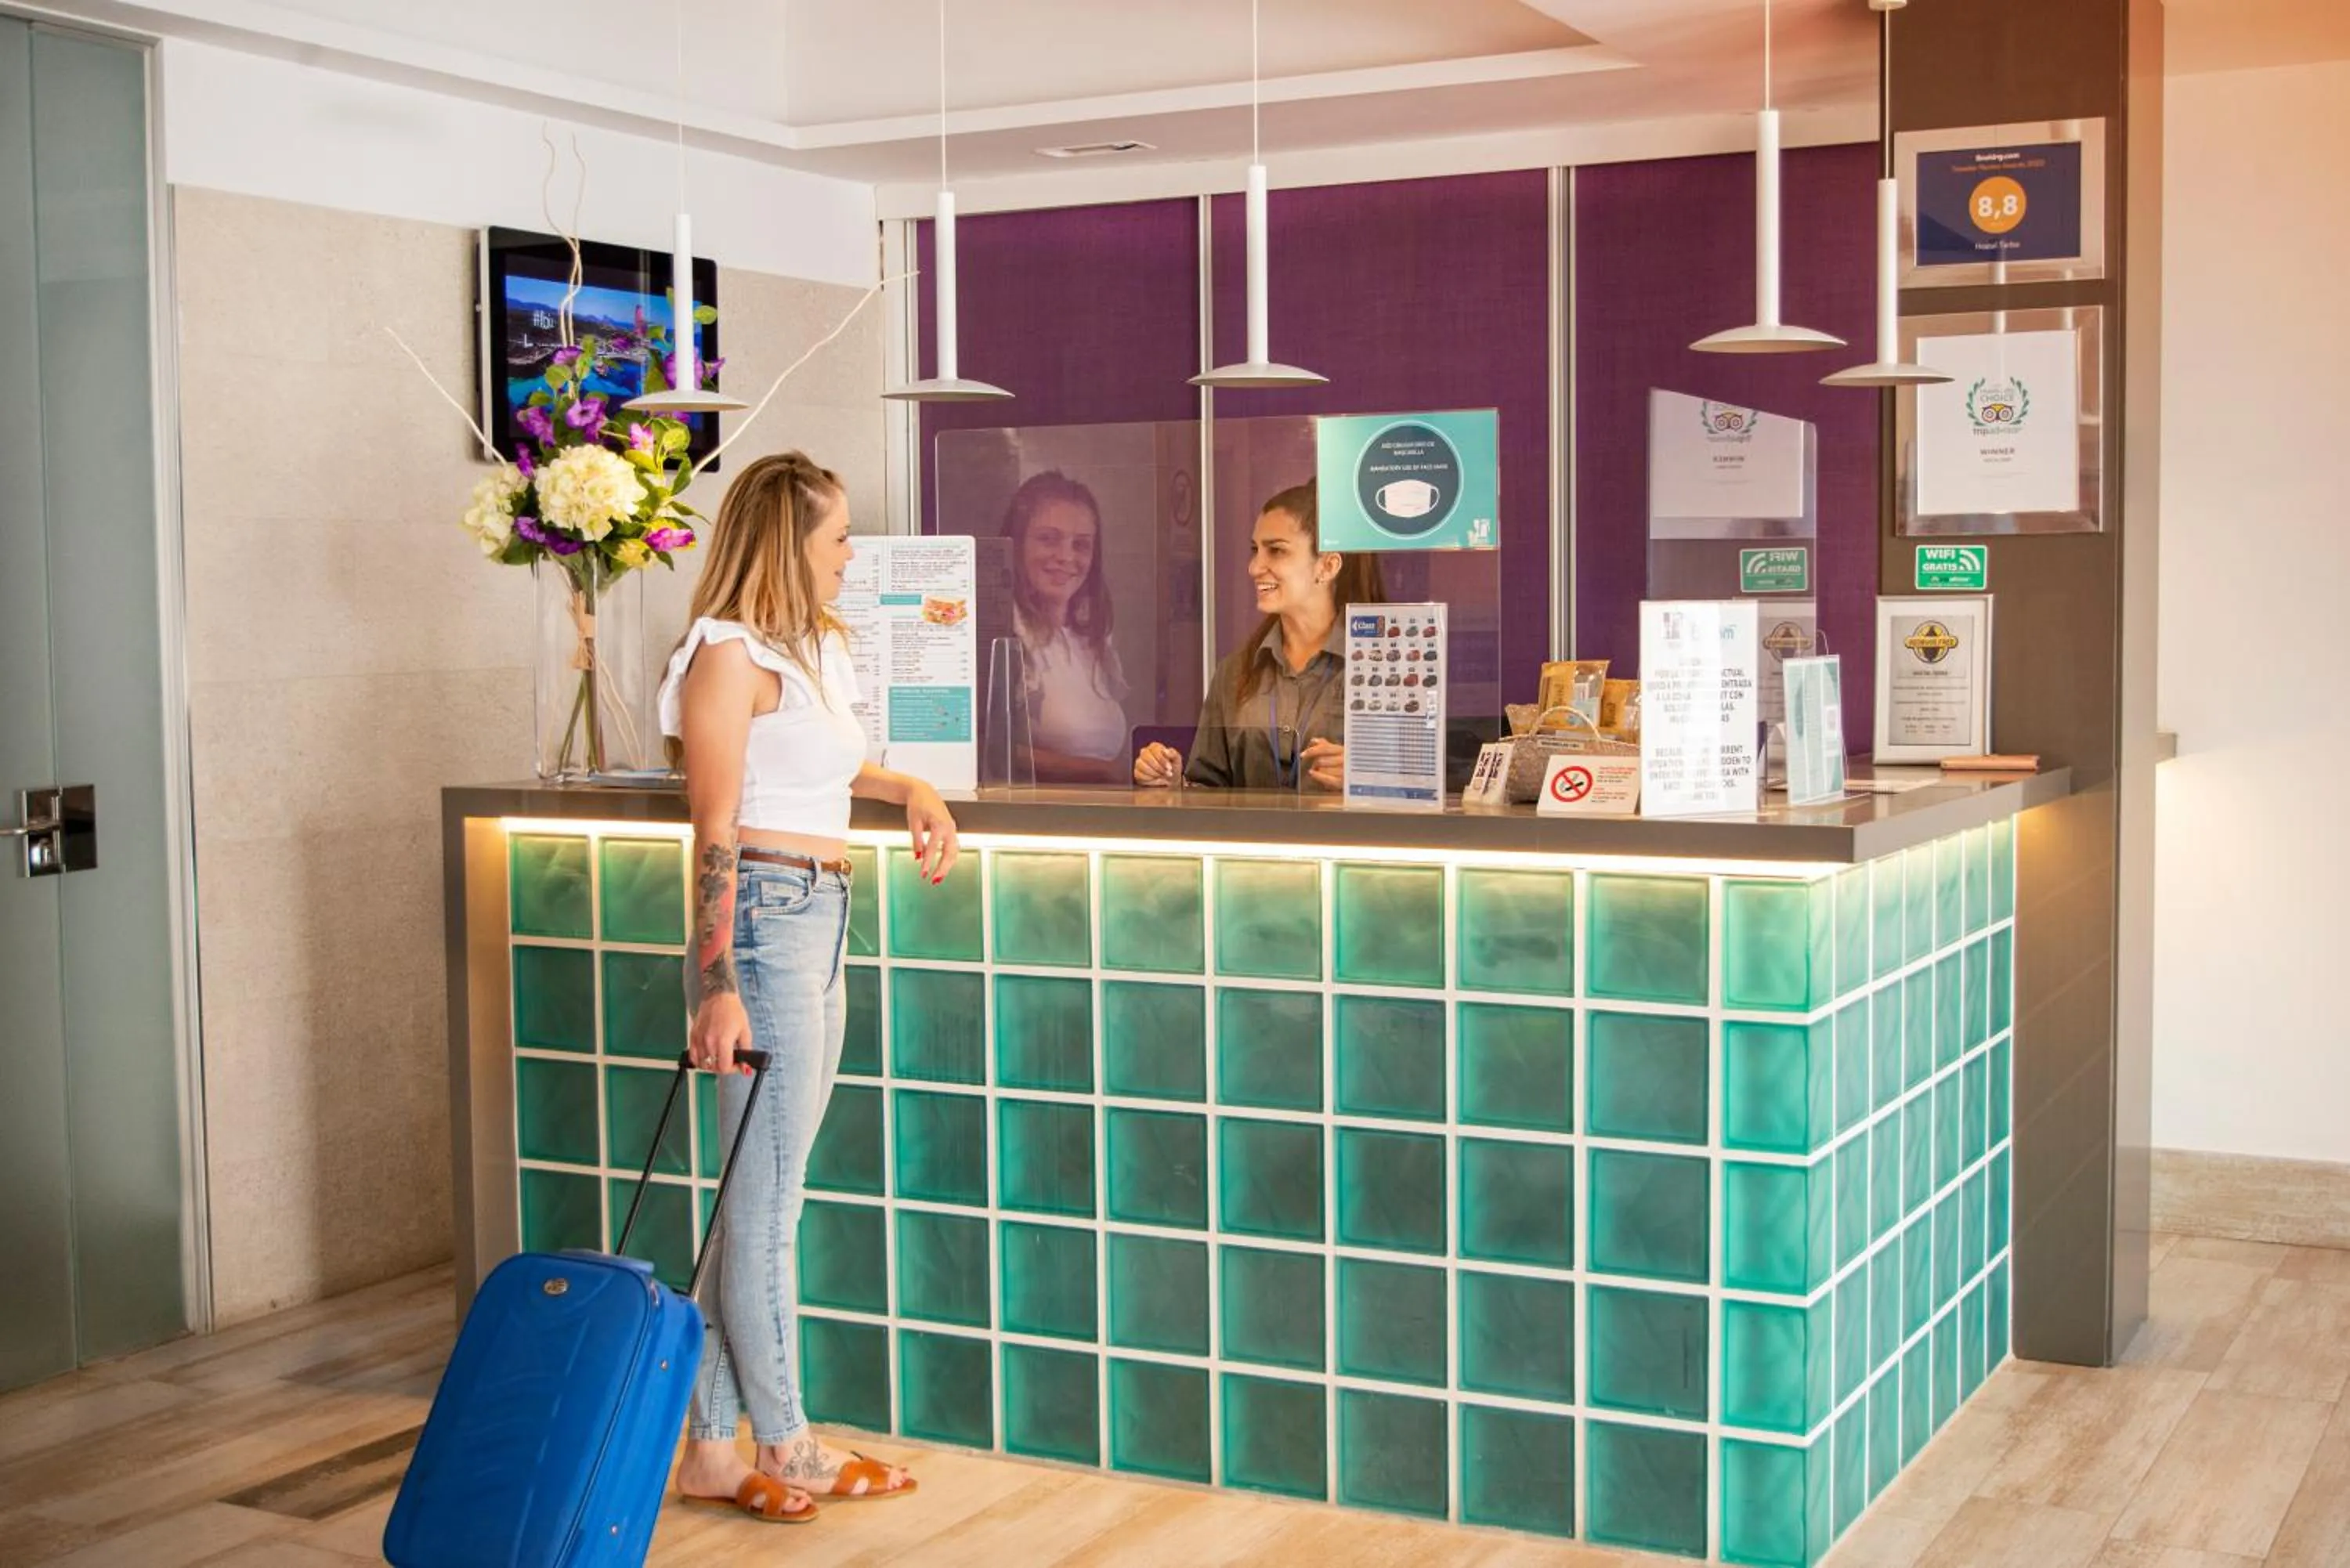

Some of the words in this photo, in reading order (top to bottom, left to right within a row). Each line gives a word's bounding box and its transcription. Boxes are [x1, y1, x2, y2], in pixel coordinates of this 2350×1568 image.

[1978, 194, 2019, 220] 8,8
[1925, 548, 1956, 560] WIFI
[1922, 562, 1958, 571] GRATIS
